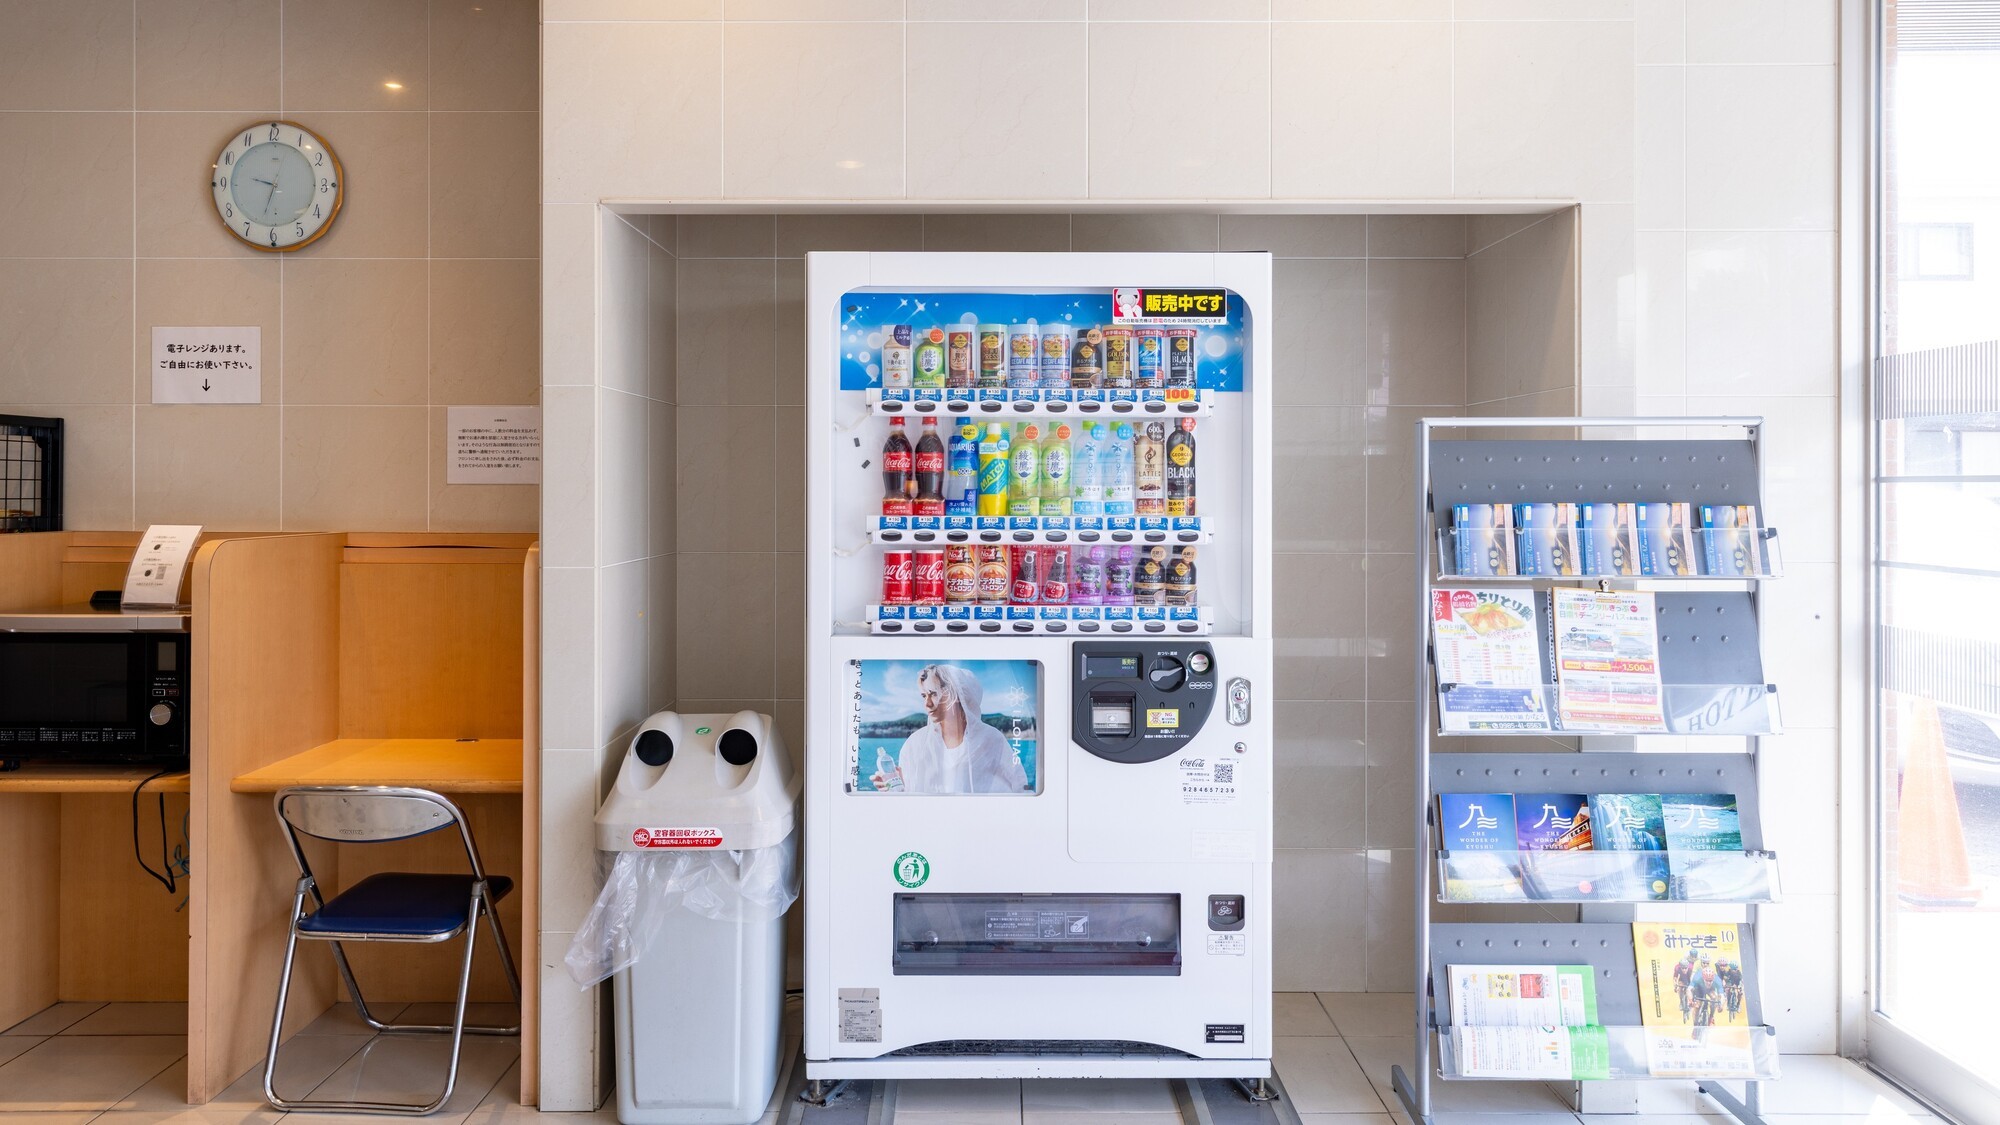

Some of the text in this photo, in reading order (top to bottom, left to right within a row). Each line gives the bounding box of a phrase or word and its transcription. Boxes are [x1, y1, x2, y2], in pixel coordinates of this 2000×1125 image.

[244, 133, 252, 146] 11
[269, 128, 280, 141] 12
[298, 134, 303, 147] 1
[225, 151, 235, 165] 10
[315, 152, 323, 166] 2
[220, 177, 227, 192] 9
[320, 178, 328, 193] 3
[226, 202, 233, 218] 8
[313, 204, 321, 219] 4
[243, 221, 251, 237] 7
[270, 227, 278, 242] 6
[296, 222, 304, 237] 5
[1145, 294, 1223, 312] 販売中です
[166, 343, 246, 353] 電子レンジあります。
[160, 360, 252, 369] ご自由にお使い下さい。
[885, 458, 911, 469] Coca-Cola
[917, 458, 943, 469] Coca-Cola
[980, 460, 1007, 492] MATCH
[1167, 467, 1196, 479] BLACK
[1453, 593, 1475, 602] OSAKA
[1121, 658, 1136, 666] 販売中
[1012, 718, 1021, 765] LOHAS
[1180, 758, 1205, 768] Coca-Cola
[654, 829, 716, 837] 空容器回収ボックス
[1664, 934, 1718, 949] みやざき
[1721, 930, 1735, 943] 10
